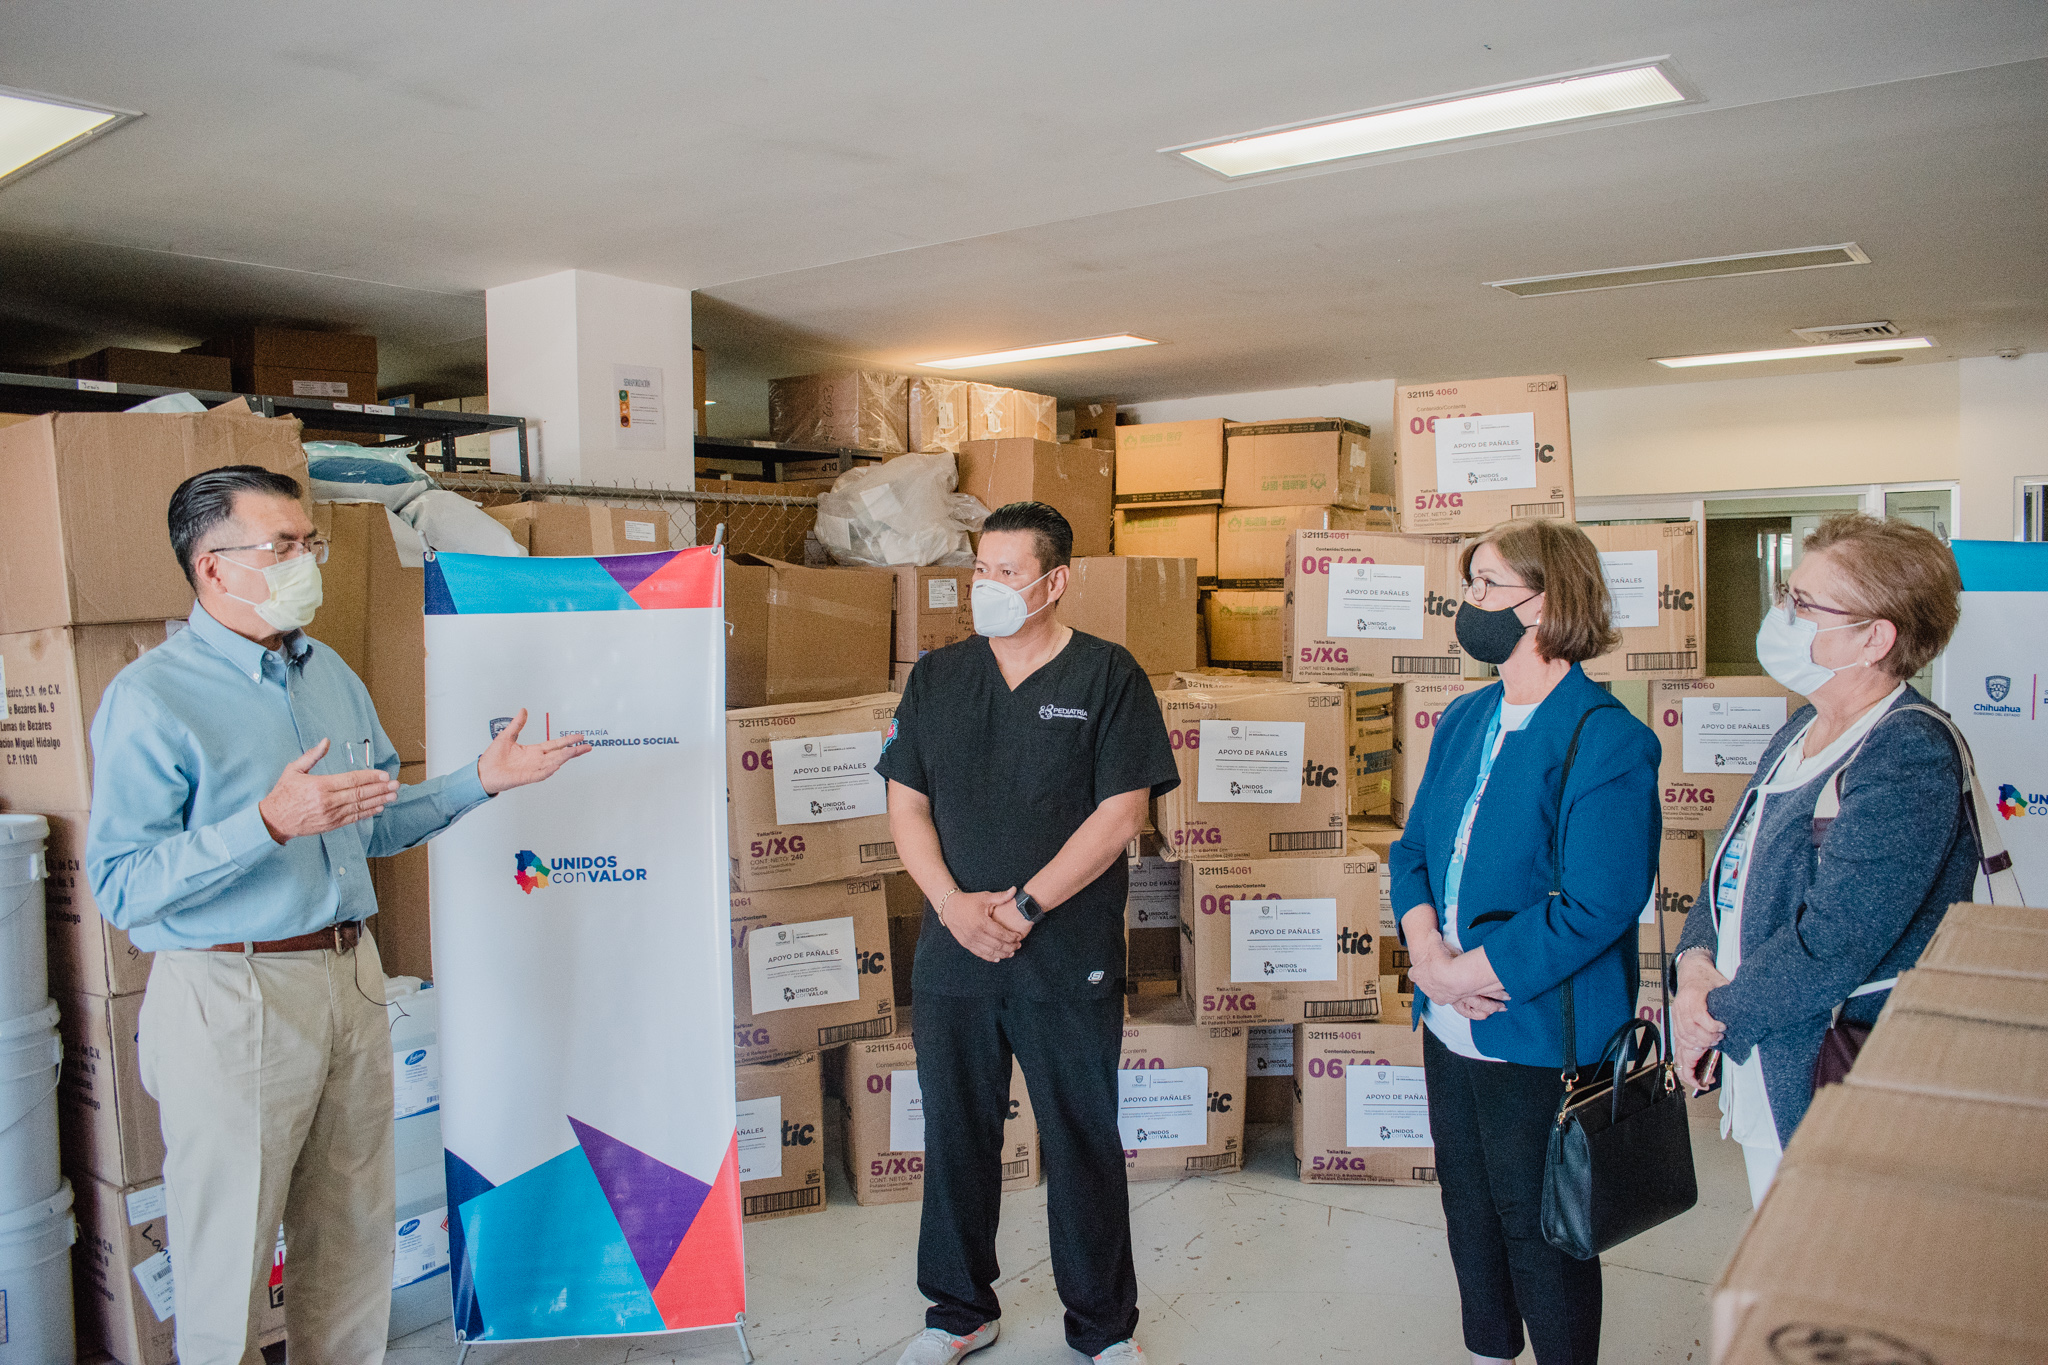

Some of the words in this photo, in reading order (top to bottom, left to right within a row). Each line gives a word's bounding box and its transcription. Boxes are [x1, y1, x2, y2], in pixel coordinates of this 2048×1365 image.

[1415, 492, 1463, 510] 5/XG
[1301, 647, 1348, 663] 5/XG
[39, 685, 47, 696] de
[48, 684, 61, 695] C.V.
[38, 703, 49, 714] No.
[50, 702, 54, 713] 9
[1054, 708, 1088, 716] PEDIATRÍA
[1974, 704, 2021, 712] Chihuahua
[0, 721, 18, 732] Lomas
[19, 721, 26, 731] de
[15, 738, 34, 750] Miguel
[36, 737, 60, 750] Hidalgo
[643, 737, 679, 745] SOCIAL
[7, 754, 17, 765] C.P.
[19, 754, 37, 765] 11910
[794, 767, 819, 775] APOYO
[833, 762, 867, 772] PAÑALES
[1665, 788, 1715, 803] 5/XG
[1174, 828, 1222, 846] 5/XG
[750, 836, 806, 858] 5/XG
[551, 856, 618, 870] UNIDOS
[552, 868, 647, 884] conVALOR
[768, 954, 792, 963] APOYO
[806, 948, 839, 957] PAÑALES
[1203, 994, 1256, 1011] 5/XG
[871, 1157, 923, 1176] 5/XG
[1312, 1156, 1365, 1171] 5/XG
